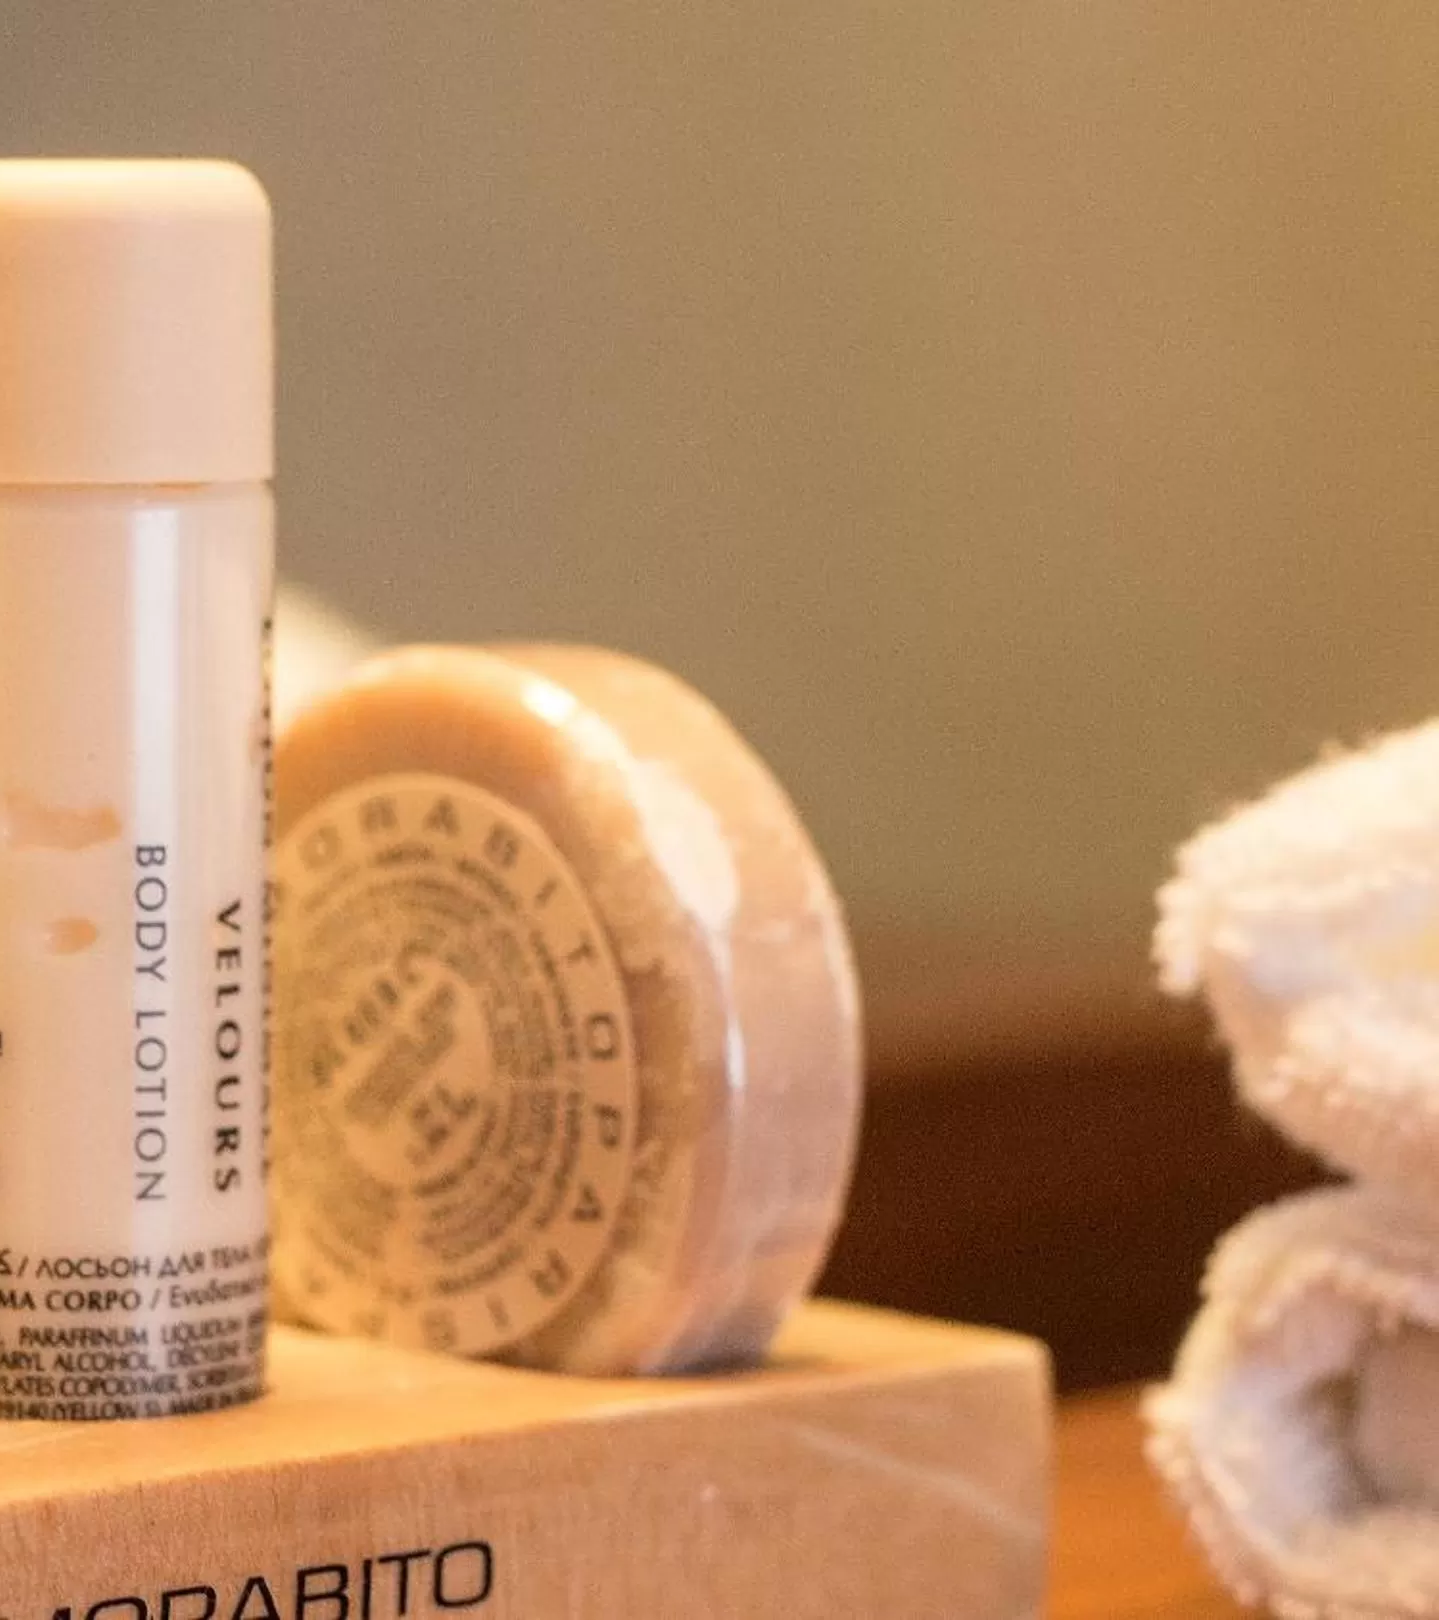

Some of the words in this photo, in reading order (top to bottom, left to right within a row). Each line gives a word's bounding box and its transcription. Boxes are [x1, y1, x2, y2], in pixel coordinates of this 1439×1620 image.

[134, 844, 168, 981] BODY
[270, 790, 622, 1064] ORABITO
[133, 1009, 168, 1201] LOTION
[213, 900, 243, 1195] VELOURS
[35, 1257, 151, 1280] ЛОСЬОН
[45, 1289, 142, 1313] CORPO
